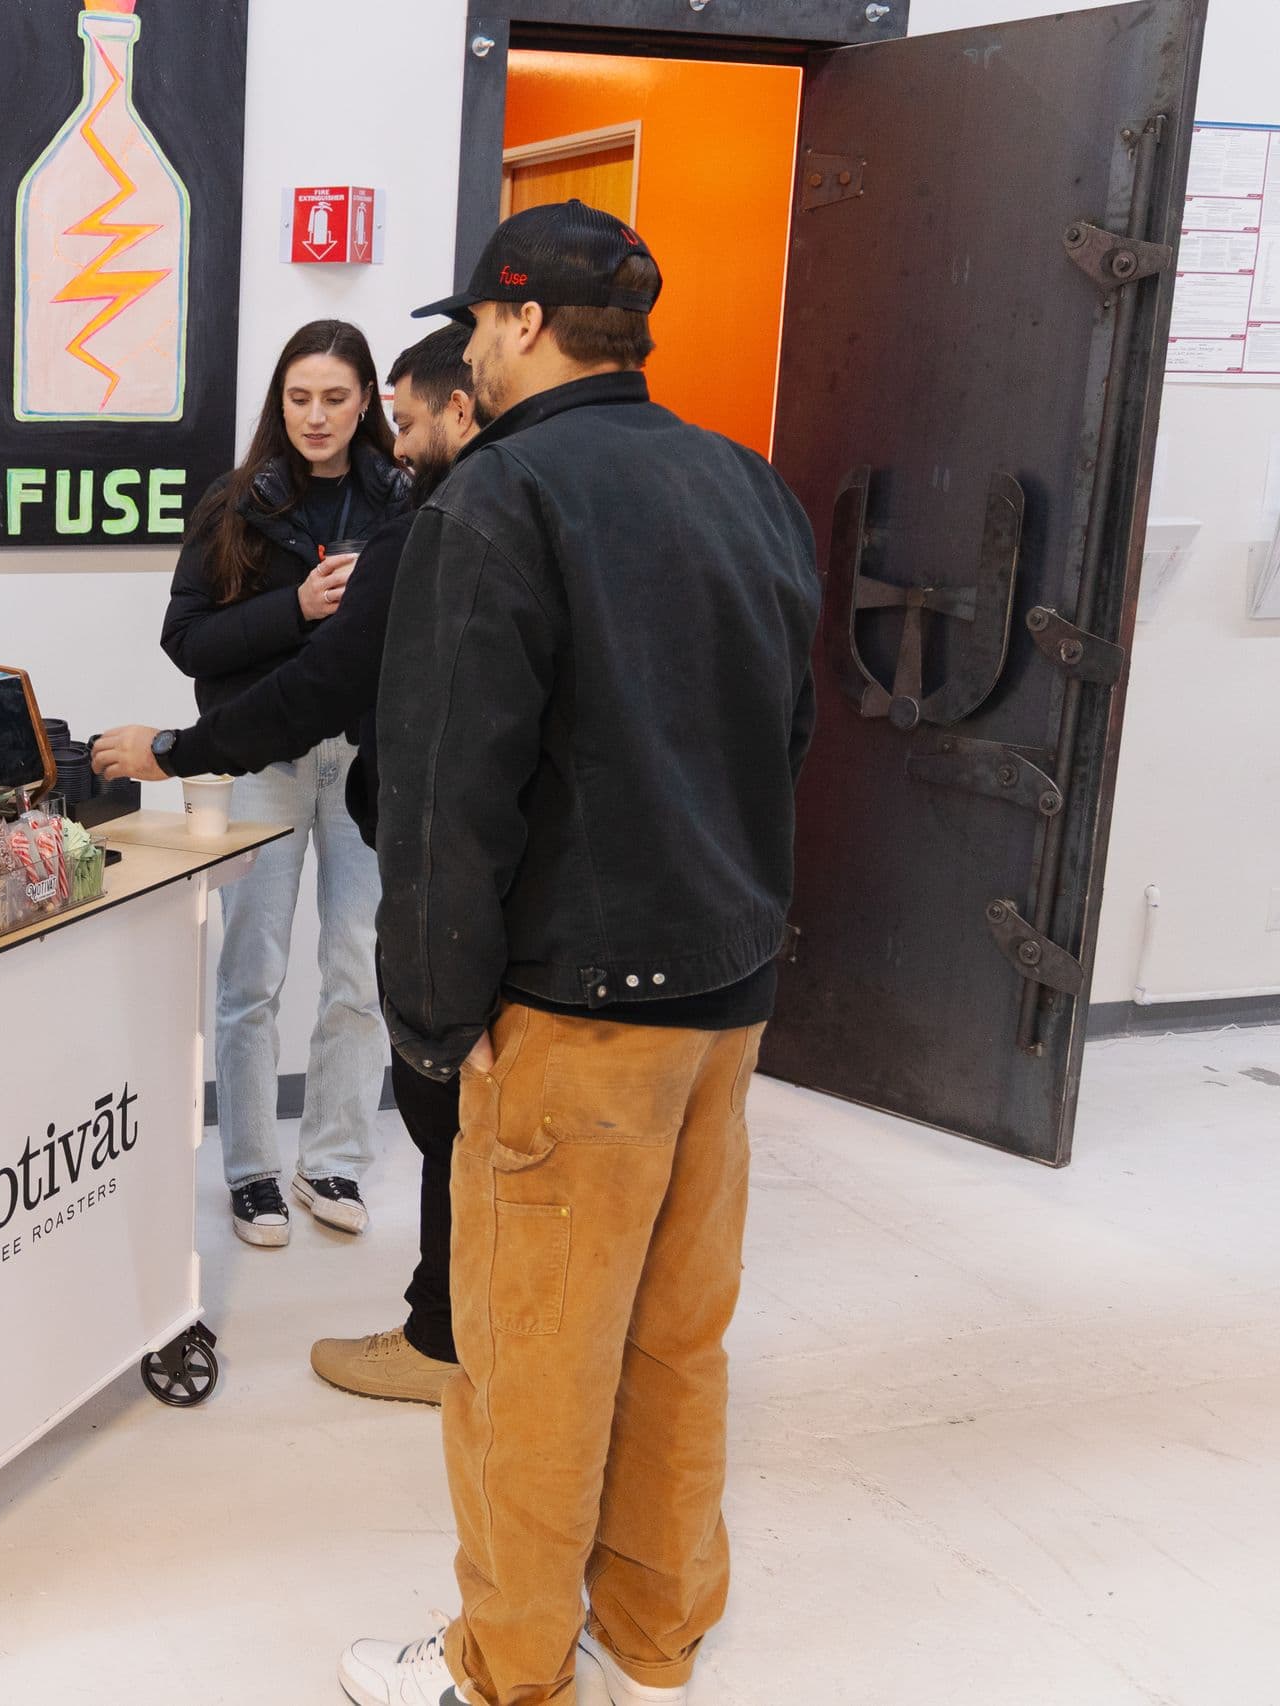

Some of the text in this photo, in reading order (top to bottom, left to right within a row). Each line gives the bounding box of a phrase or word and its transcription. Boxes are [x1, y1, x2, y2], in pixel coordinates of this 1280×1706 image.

[500, 265, 528, 286] fuse
[7, 468, 186, 535] FUSE
[32, 1178, 117, 1243] ROASTERS
